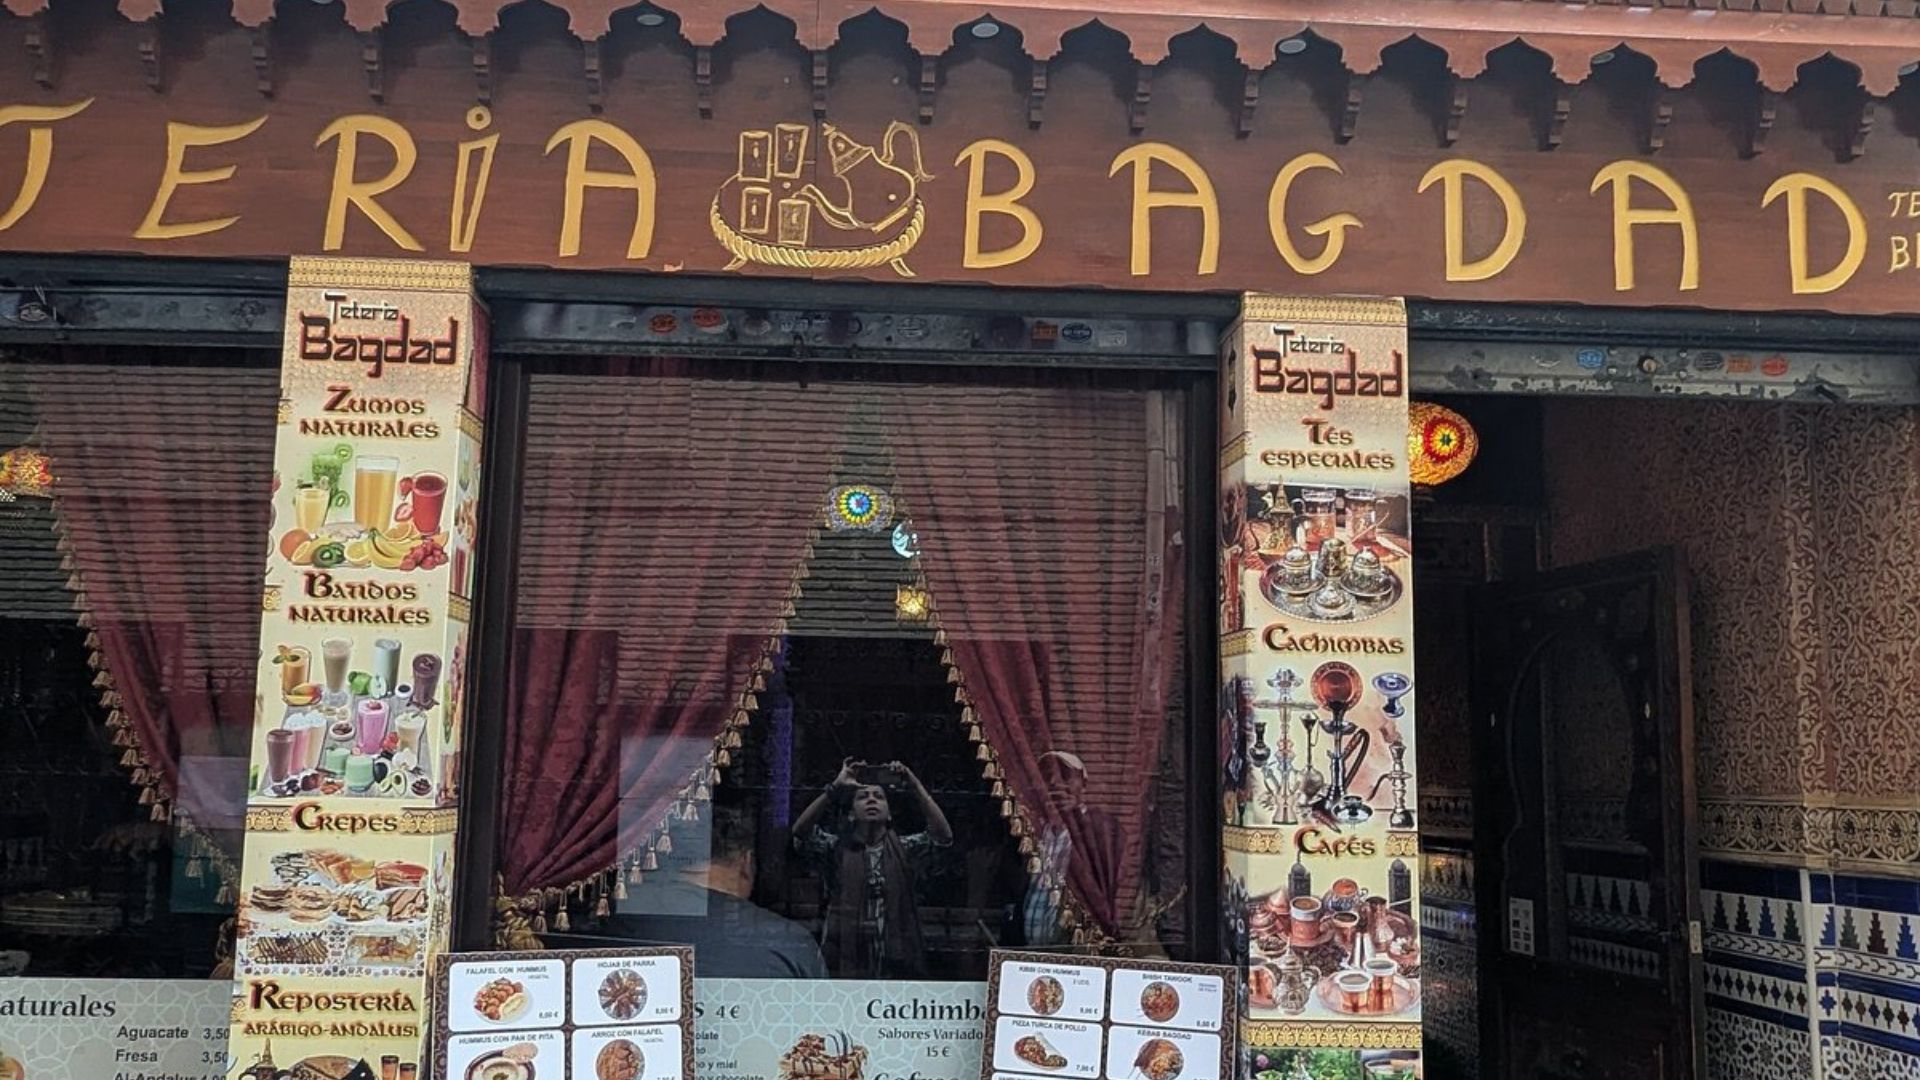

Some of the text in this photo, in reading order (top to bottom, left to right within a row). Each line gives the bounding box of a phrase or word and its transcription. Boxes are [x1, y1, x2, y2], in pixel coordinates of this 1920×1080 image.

[954, 139, 1868, 294] BAGDAD
[299, 310, 459, 378] Bagdad
[1251, 344, 1402, 410] Bagdad
[716, 1004, 725, 1019] 4
[730, 1004, 741, 1019] €
[116, 1025, 189, 1041] Aguacate
[493, 1035, 510, 1043] CON
[878, 1027, 931, 1040] Sabores
[115, 1049, 158, 1062] Fresa
[927, 1046, 950, 1057] 15 €
[716, 1060, 738, 1069] miel
